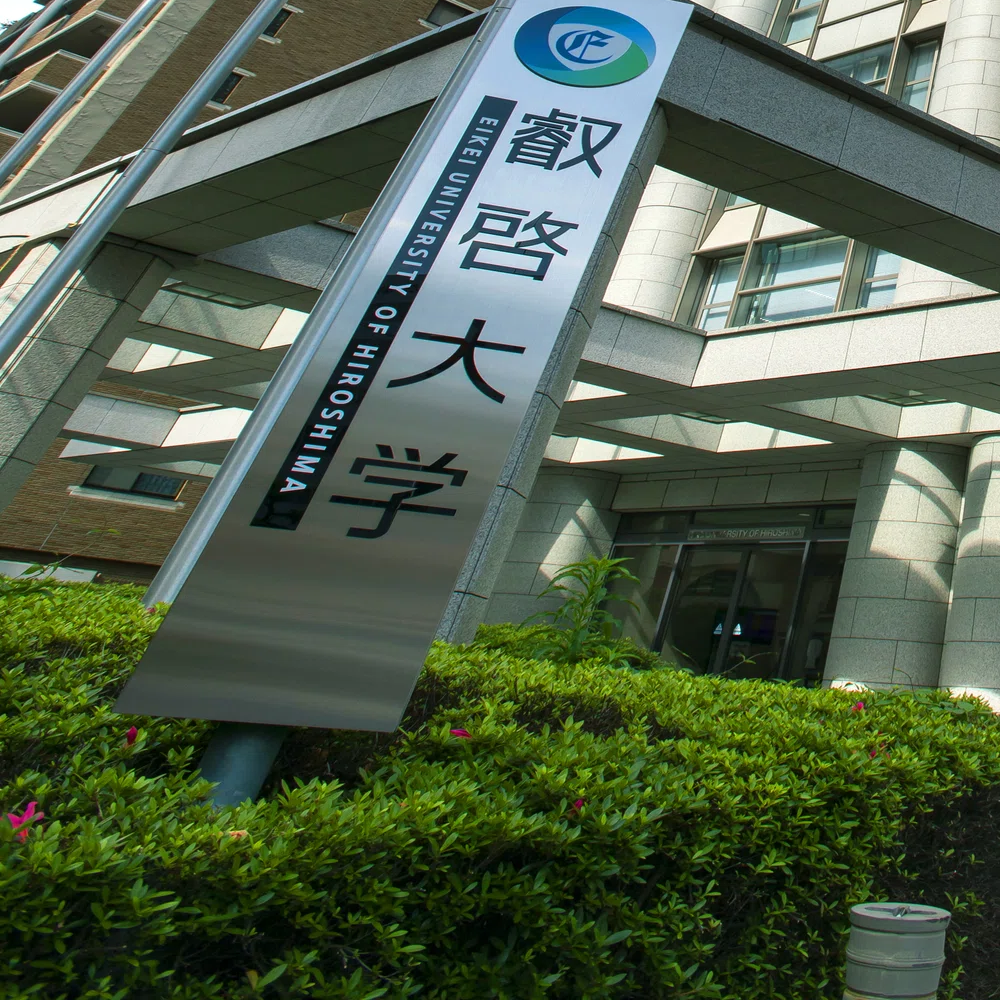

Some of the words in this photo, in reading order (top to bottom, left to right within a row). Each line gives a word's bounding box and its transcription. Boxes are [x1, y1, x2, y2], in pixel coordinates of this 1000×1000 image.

[457, 115, 500, 166] EIKEI
[388, 171, 471, 297] UNIVERSITY
[328, 107, 623, 540] 叡啓大学
[367, 305, 399, 336] OF
[279, 343, 380, 493] HIROSHIMA
